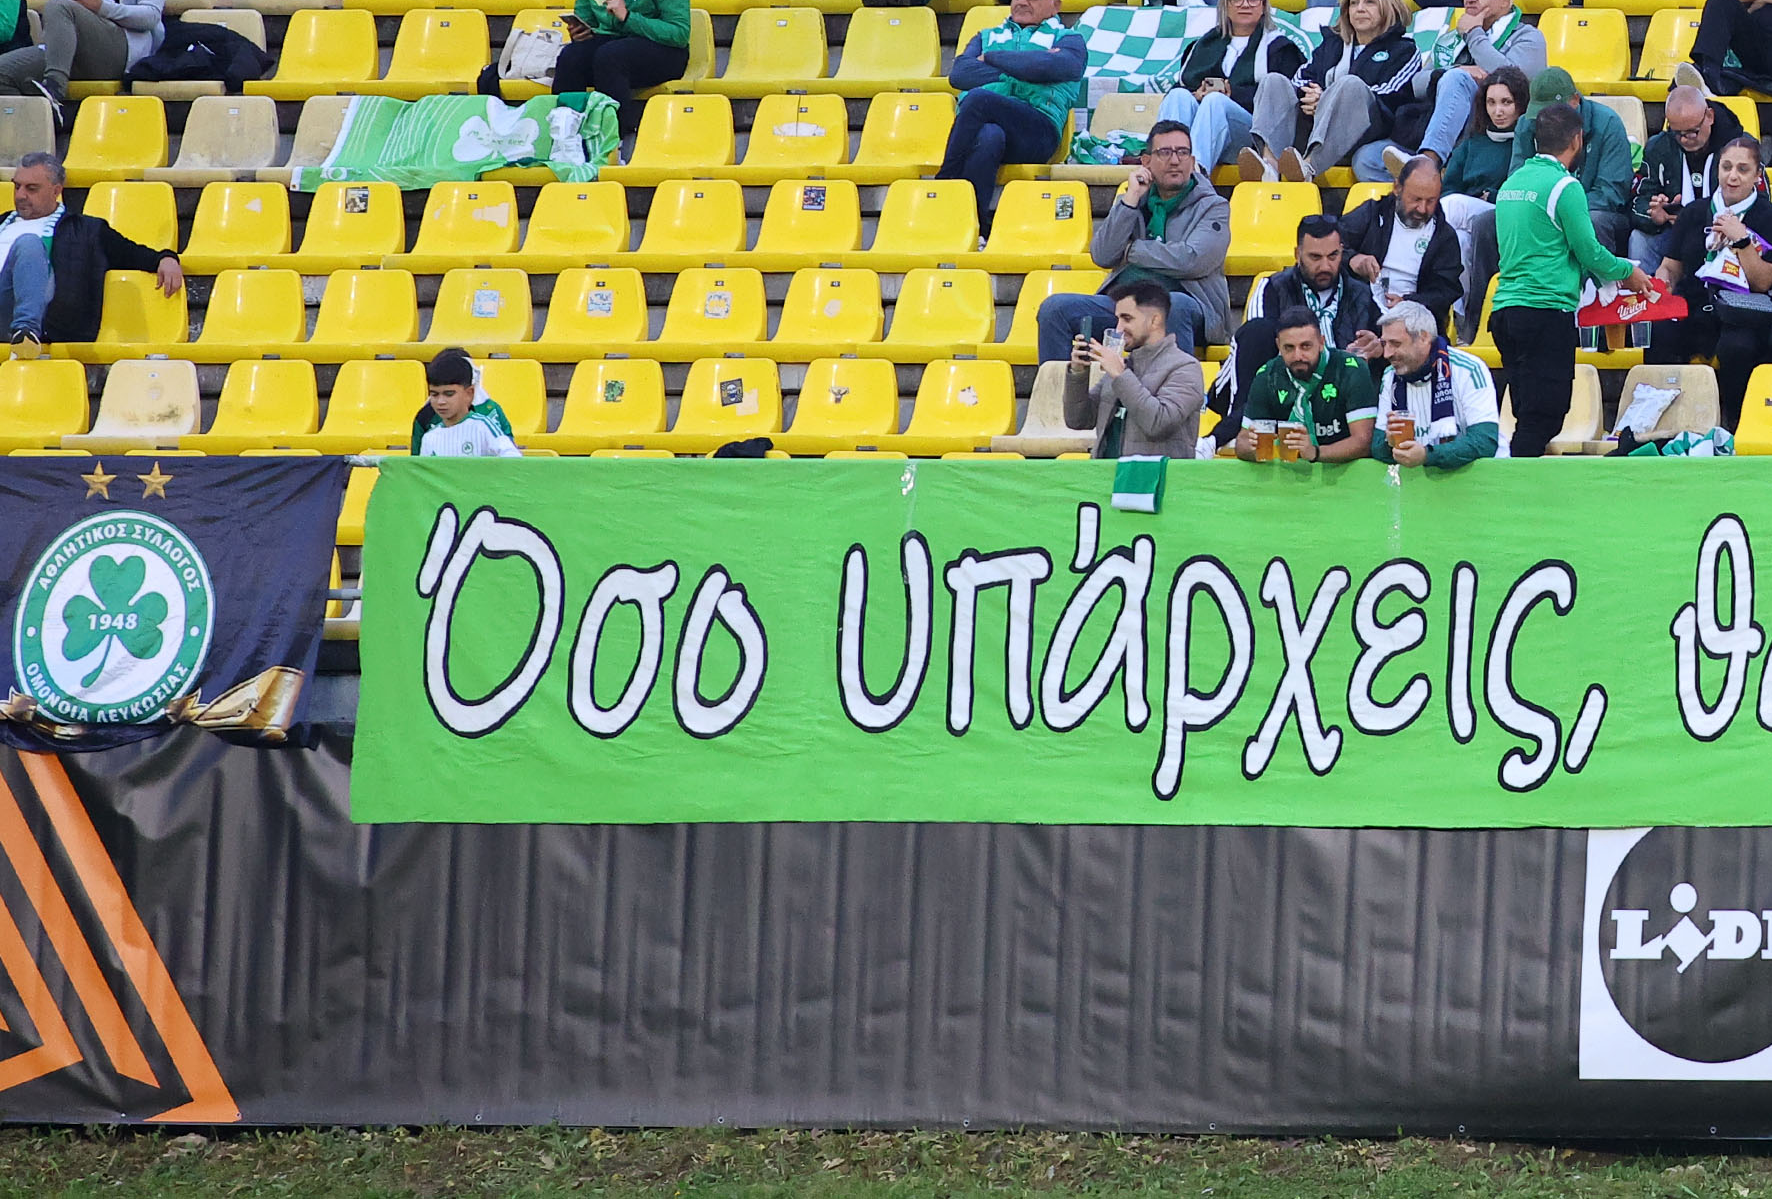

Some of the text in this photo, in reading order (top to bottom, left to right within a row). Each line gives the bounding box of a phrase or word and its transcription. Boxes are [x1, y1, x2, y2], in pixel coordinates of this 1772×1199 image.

[1617, 300, 1648, 319] Union
[38, 523, 201, 593] ΑΘΛΗΤΙΚΟΣ ΣΥΛΛΟΓΟΣ
[87, 613, 138, 631] 1948
[417, 502, 769, 740] Όσο
[837, 501, 1608, 800] υπάρχεις,
[26, 662, 189, 724] ΟΜΟΝΟΙΑ ΛΕΥΚΩΣΙΑΣ
